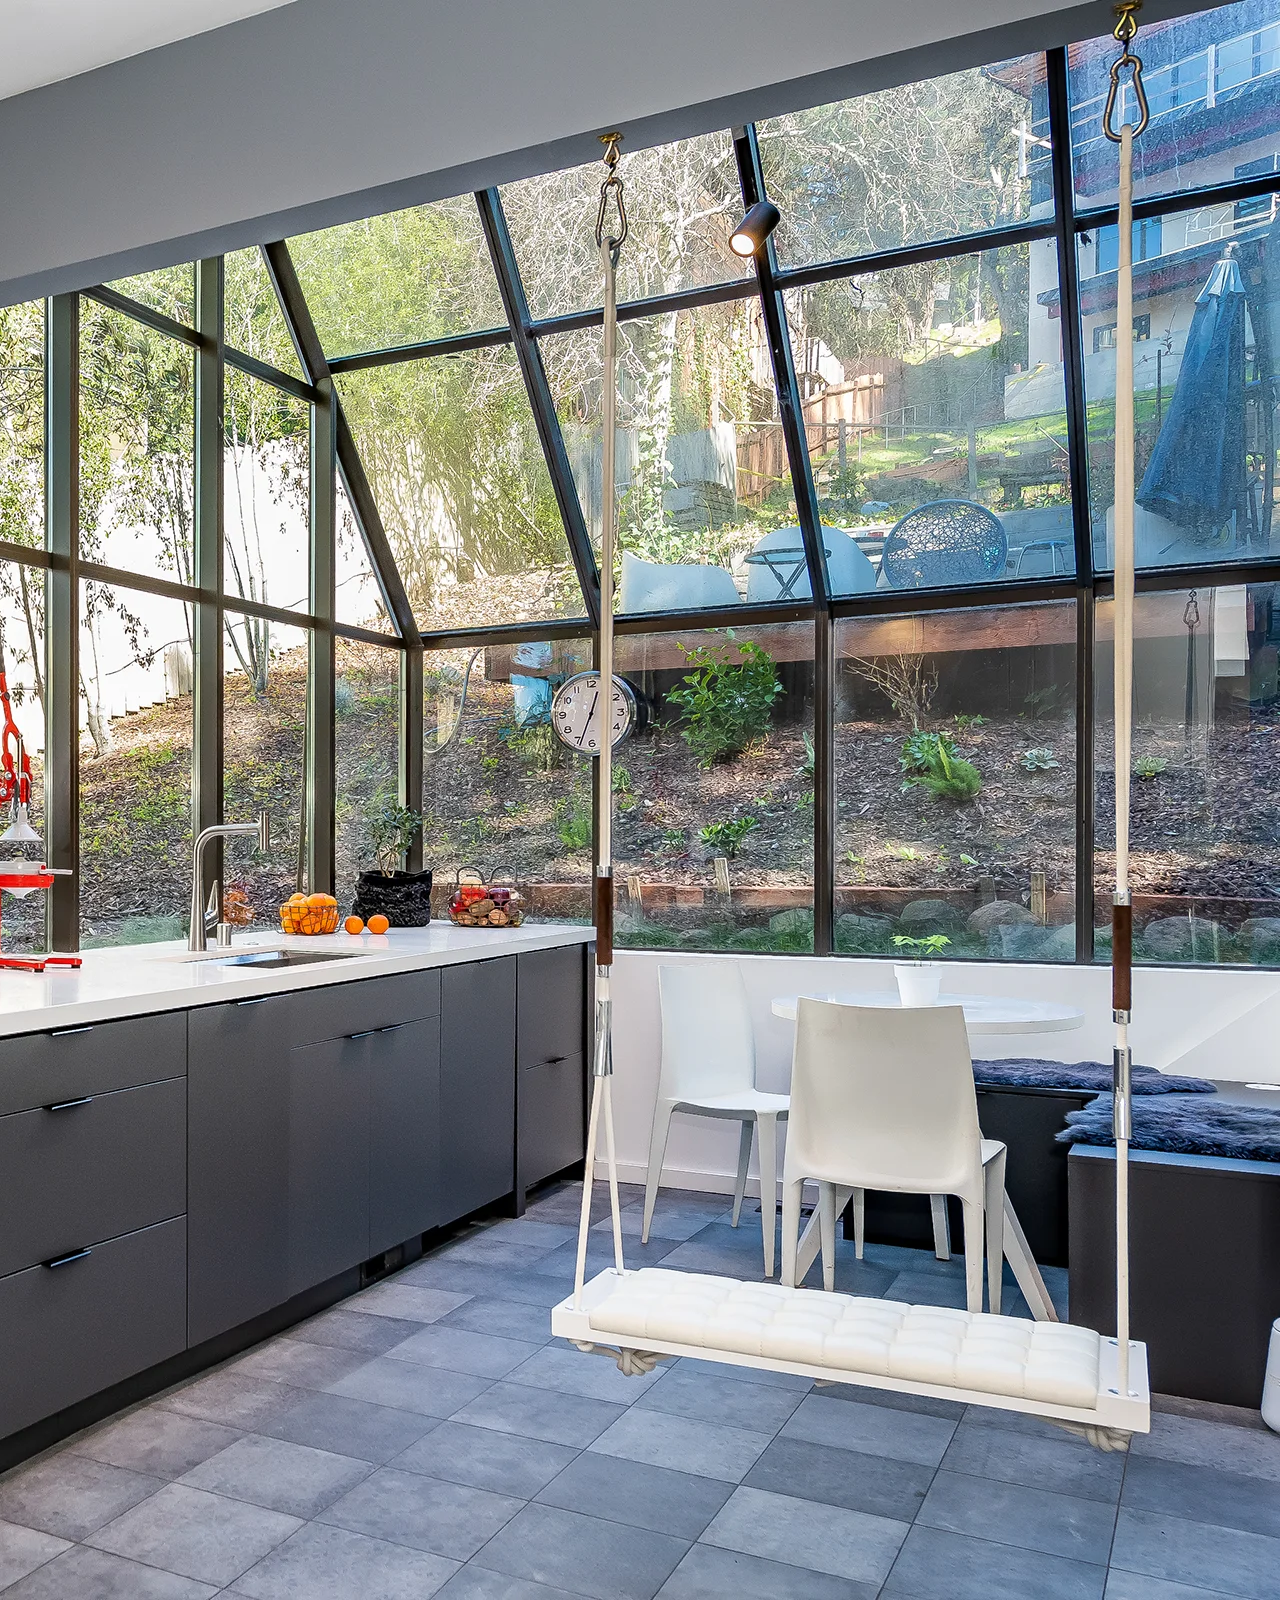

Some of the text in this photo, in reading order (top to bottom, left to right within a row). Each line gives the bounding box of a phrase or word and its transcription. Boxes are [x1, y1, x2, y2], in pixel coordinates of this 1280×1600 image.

[558, 712, 566, 720] 9
[617, 708, 624, 716] 3
[613, 723, 621, 731] 4
[574, 736, 581, 744] 7
